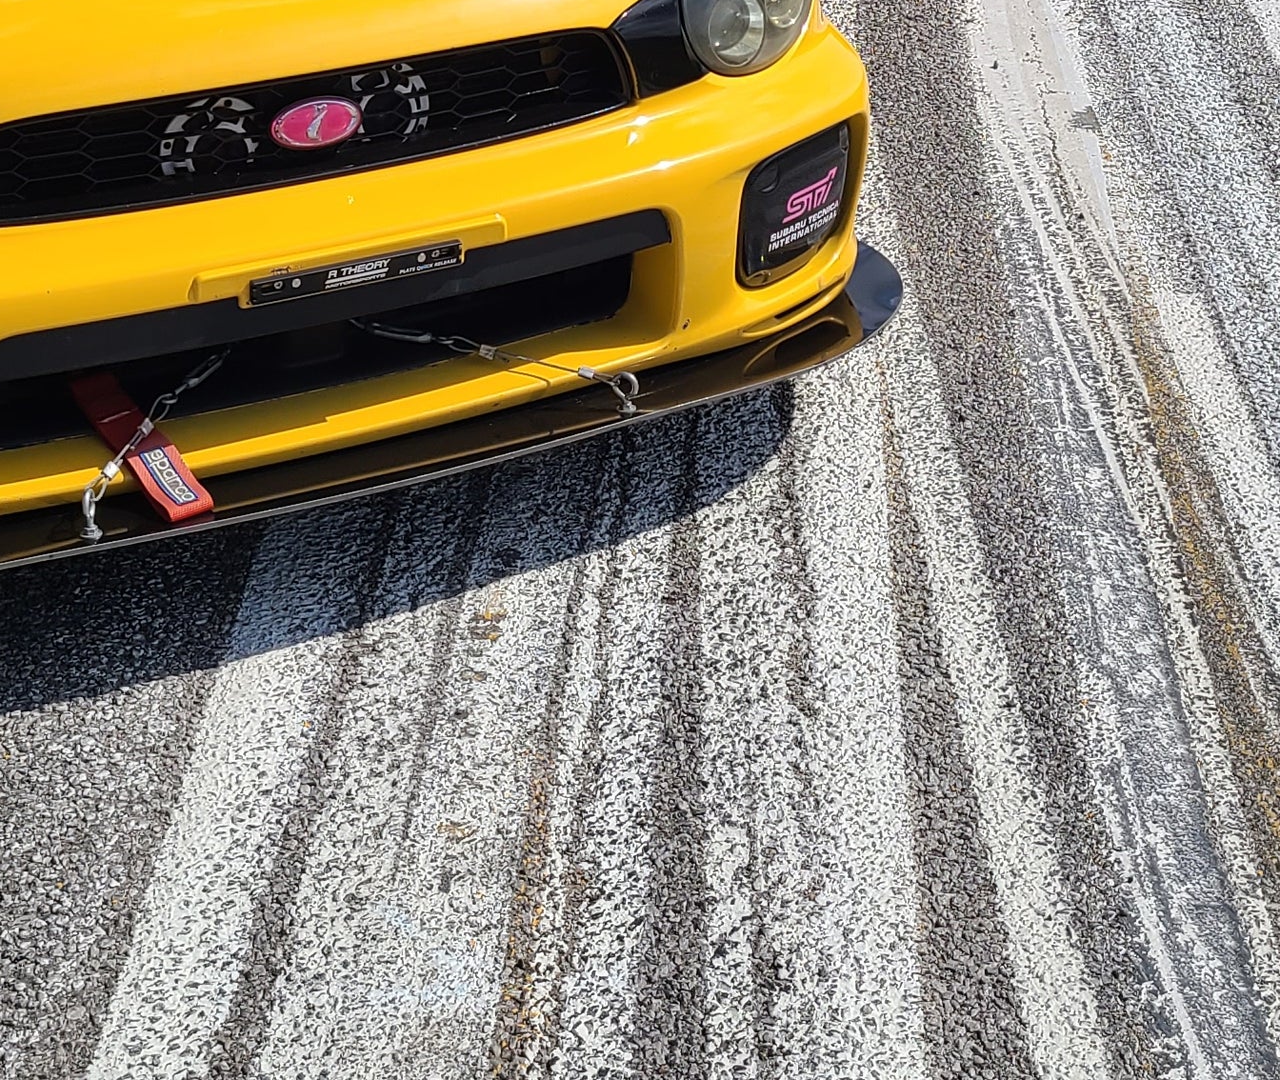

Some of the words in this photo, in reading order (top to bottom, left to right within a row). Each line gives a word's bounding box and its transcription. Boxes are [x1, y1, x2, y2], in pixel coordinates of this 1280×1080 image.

[768, 210, 838, 252] INTERNATIONAL
[770, 218, 807, 243] SUBARU
[808, 200, 840, 224] TECNICA
[341, 259, 391, 276] THEORY
[147, 448, 195, 501] sparco
